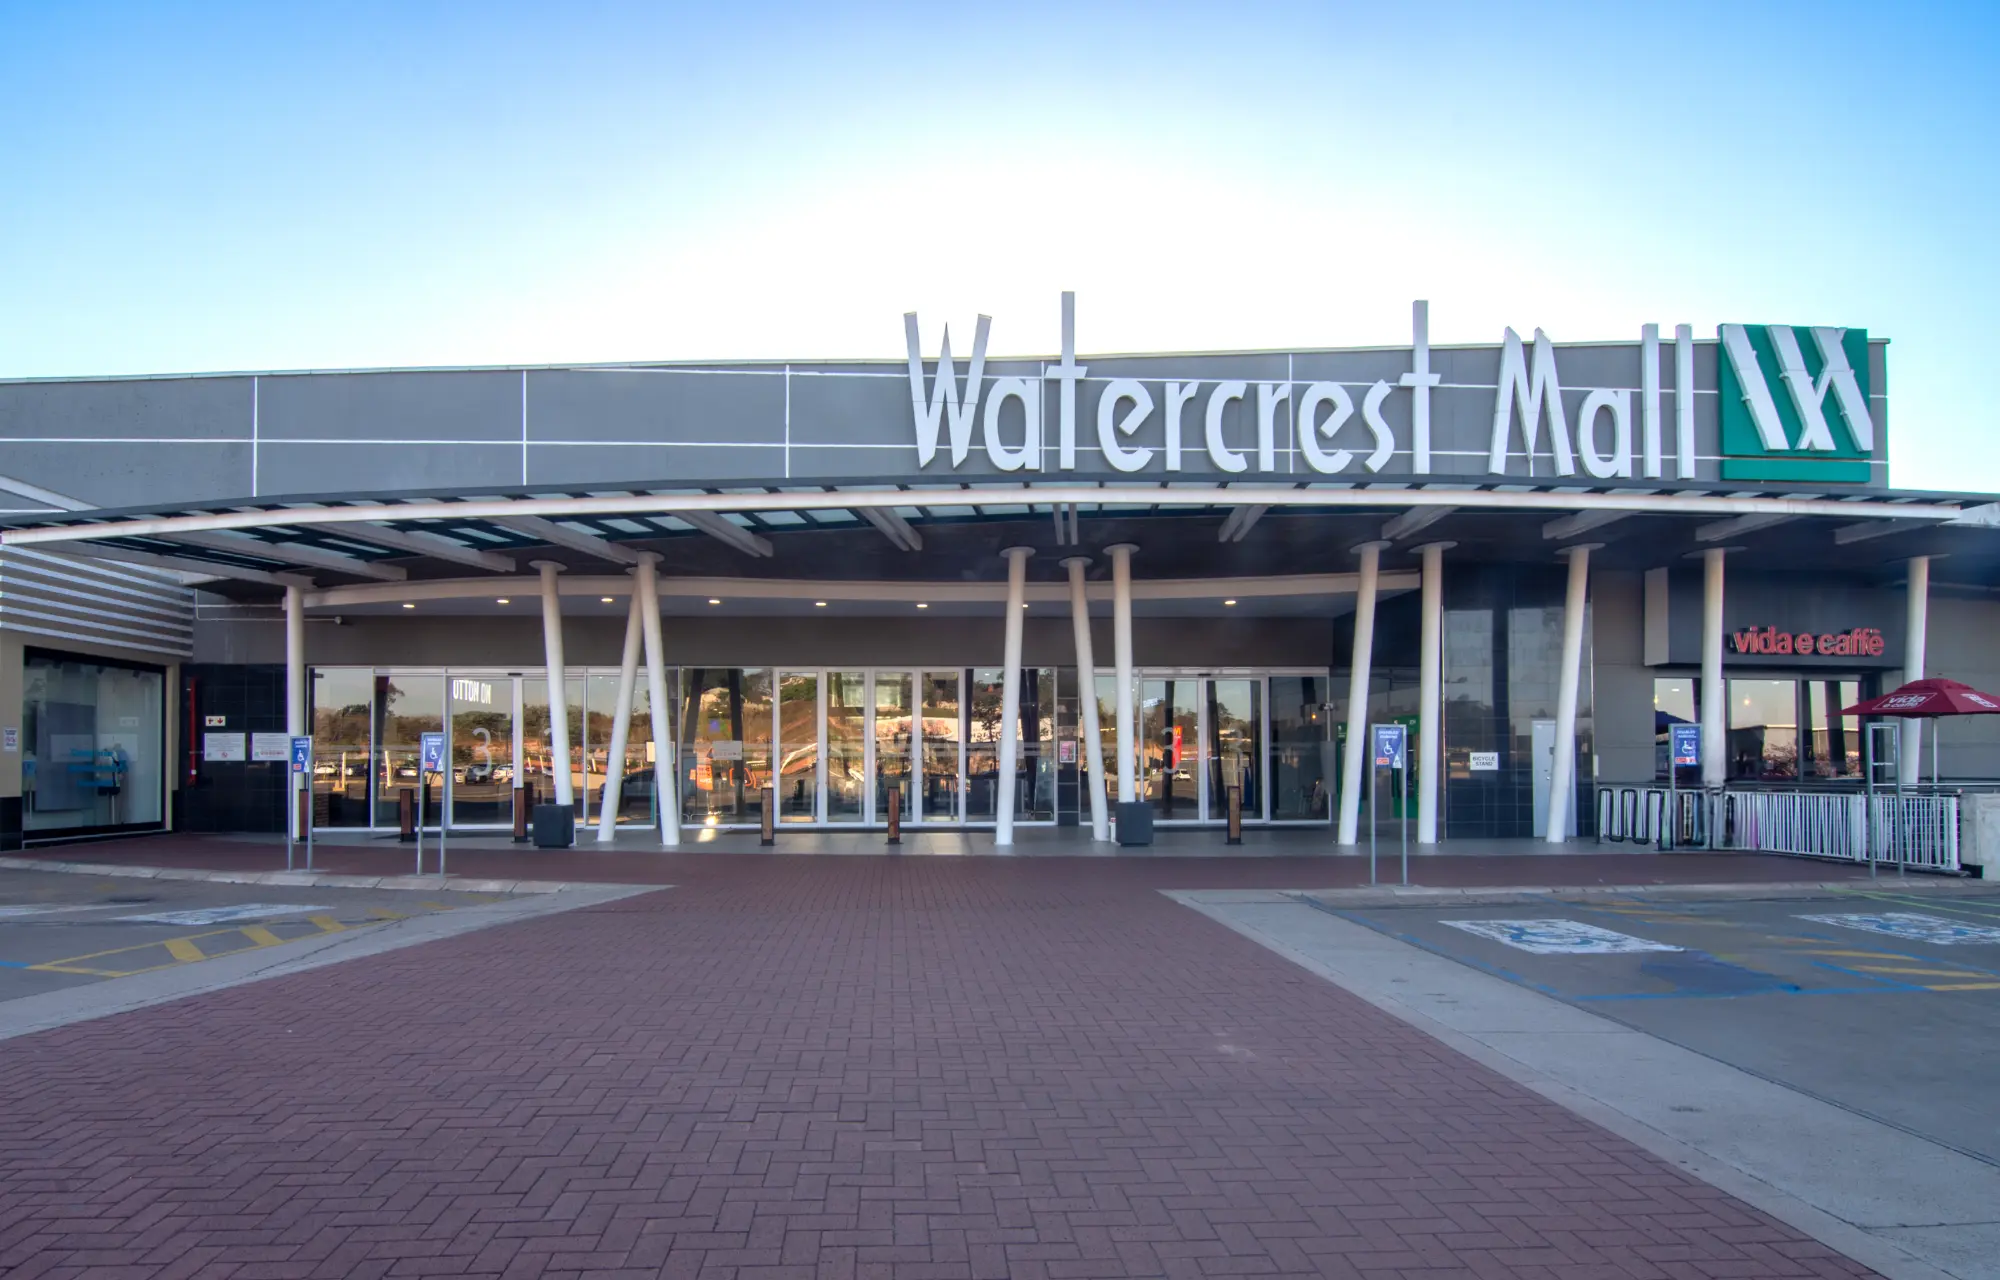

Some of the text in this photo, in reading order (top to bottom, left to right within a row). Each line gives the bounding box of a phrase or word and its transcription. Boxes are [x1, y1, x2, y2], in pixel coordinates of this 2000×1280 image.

[903, 291, 1695, 480] Watercrest Mall
[1734, 624, 1793, 655] vida
[1795, 633, 1814, 655] e
[480, 682, 492, 705] ON
[1888, 694, 1927, 704] vida
[472, 727, 493, 777] 3
